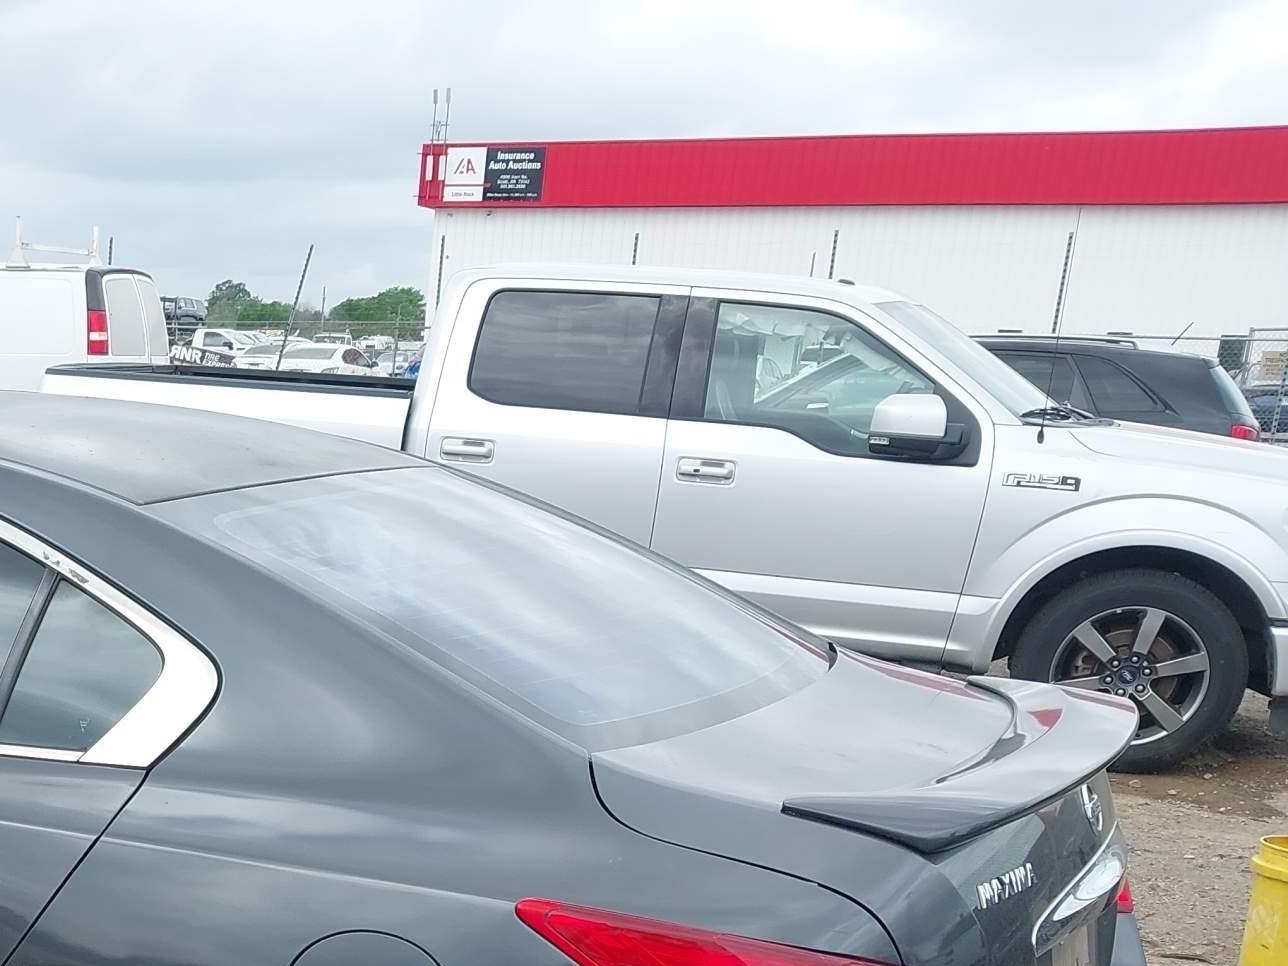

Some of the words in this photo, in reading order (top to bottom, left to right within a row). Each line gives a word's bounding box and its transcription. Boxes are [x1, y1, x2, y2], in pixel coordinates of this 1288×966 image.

[497, 151, 534, 160] Insurance
[488, 161, 506, 170] Auto
[507, 161, 541, 170] Auctions
[976, 862, 1037, 910] MAXIMA
